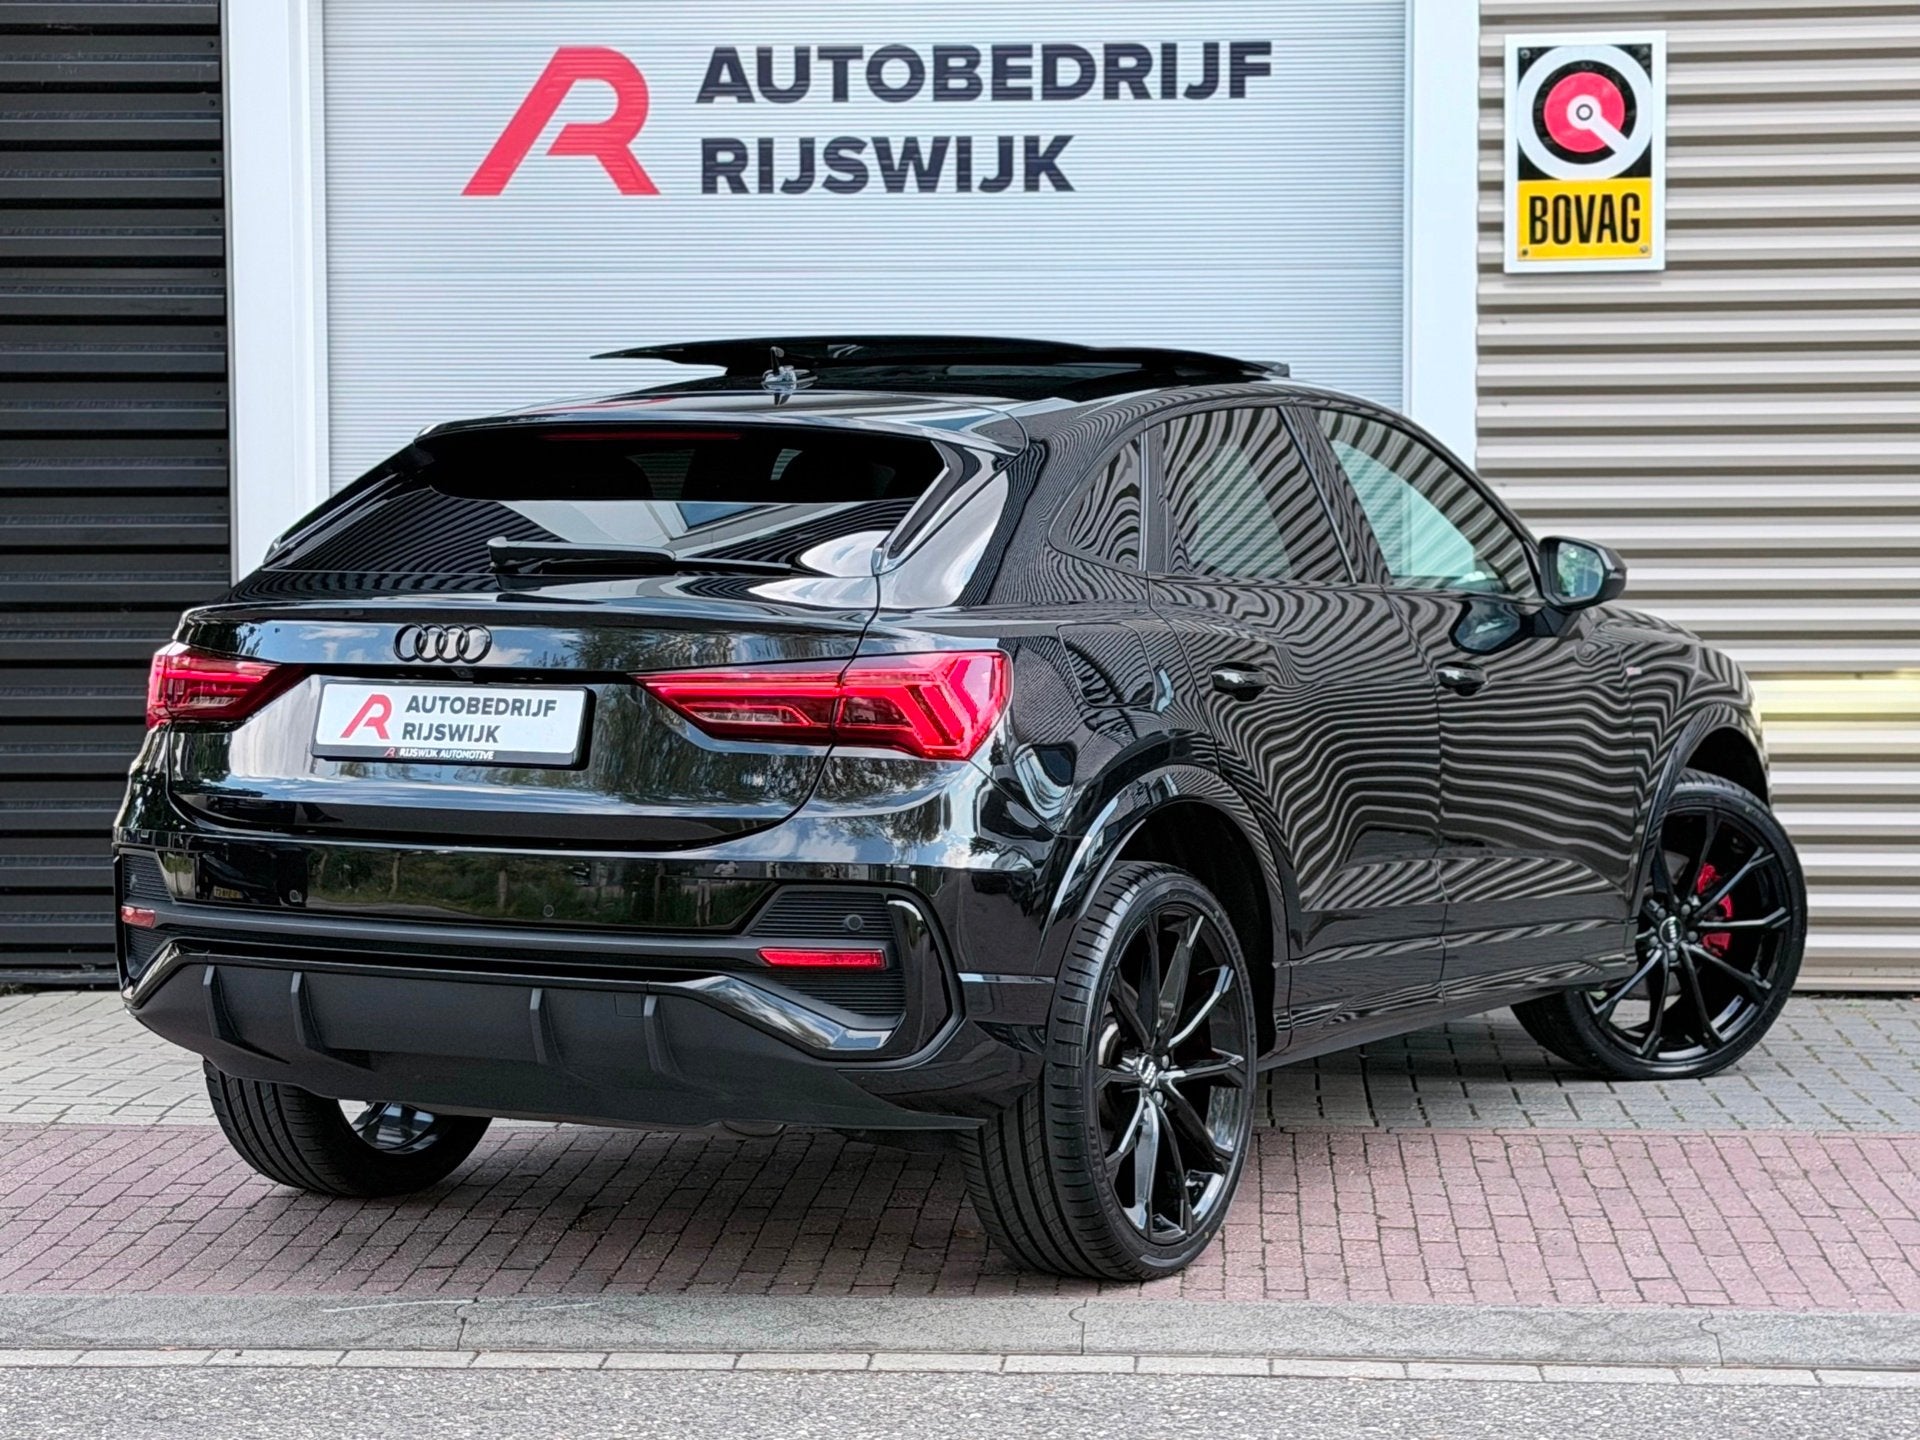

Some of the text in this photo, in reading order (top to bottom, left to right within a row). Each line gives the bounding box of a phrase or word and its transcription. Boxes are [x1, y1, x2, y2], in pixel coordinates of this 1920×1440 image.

[697, 41, 1272, 104] AUTOBEDRIJF
[701, 135, 1074, 195] RIJSWIJK
[1529, 192, 1641, 245] BOVAG
[405, 695, 557, 717] AUTOBEDRIJF
[402, 722, 500, 743] RIJSWIJK
[400, 748, 438, 758] RIJSWIJK
[439, 749, 494, 760] AUTOMOTIVE
